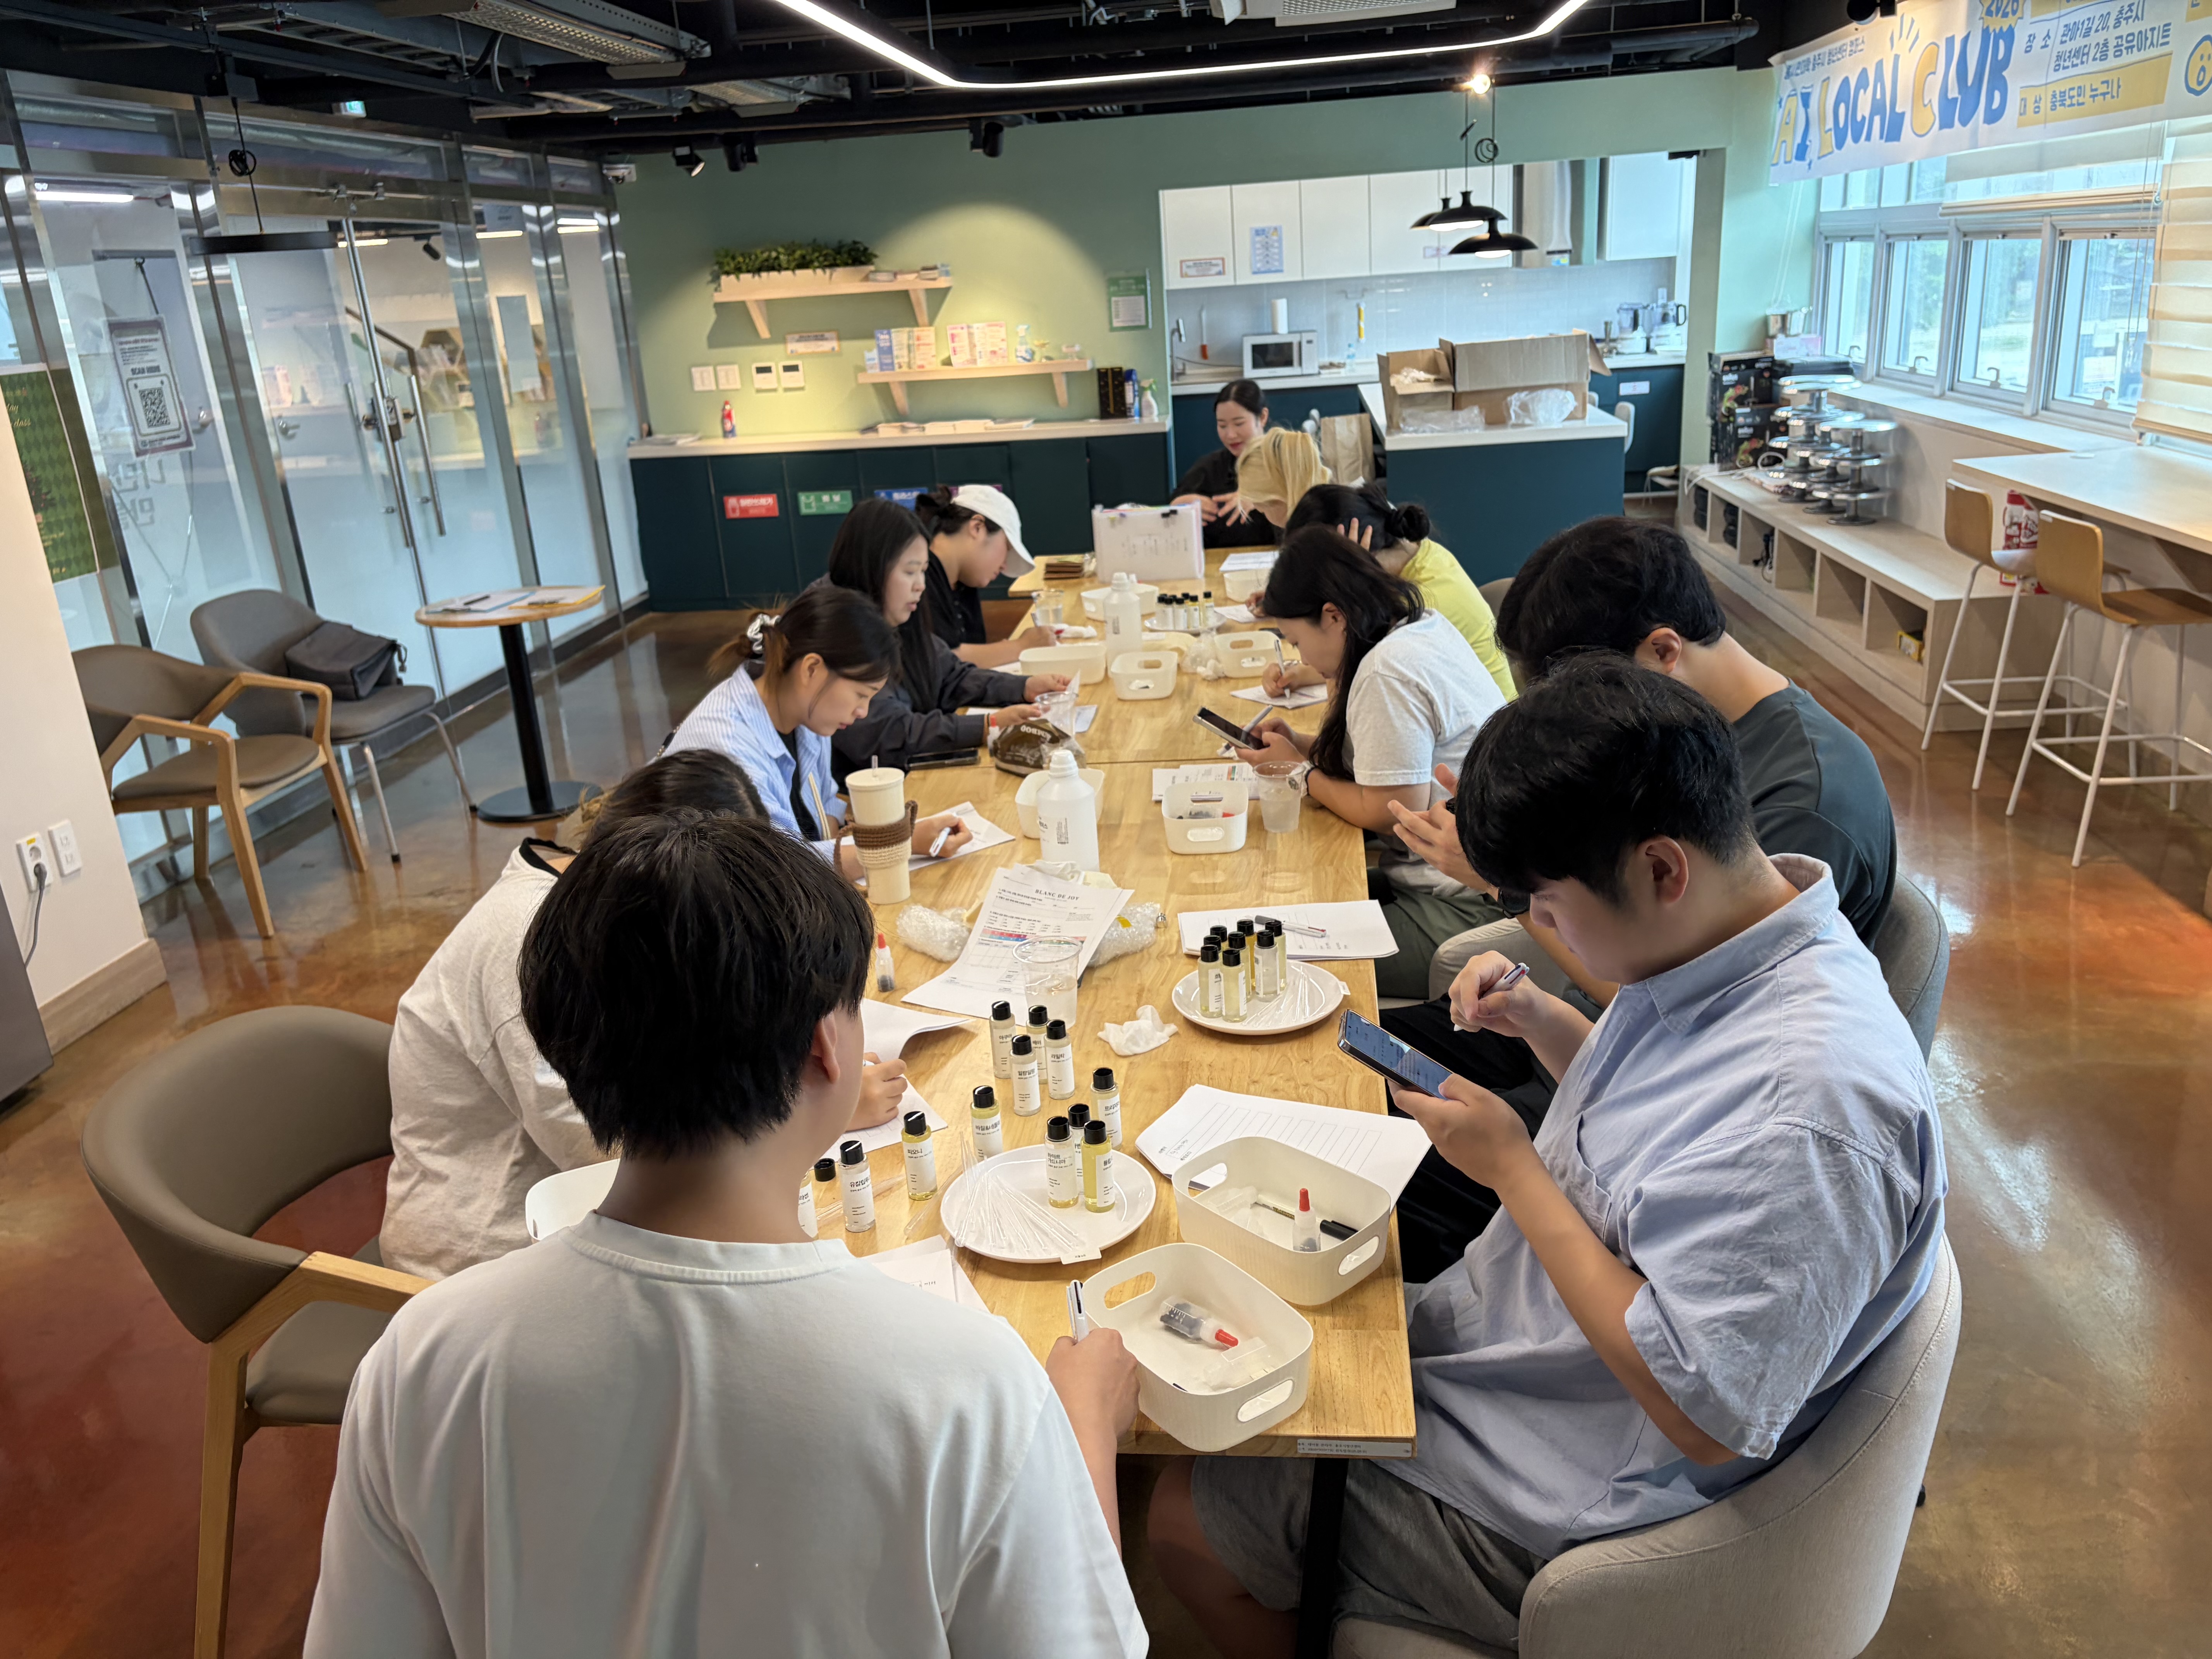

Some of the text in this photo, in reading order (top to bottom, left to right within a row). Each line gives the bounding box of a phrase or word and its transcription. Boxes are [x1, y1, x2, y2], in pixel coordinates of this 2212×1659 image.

[2060, 0, 2144, 45] 관아1길 20, 충주시
[2053, 22, 2172, 73] 청년센터 2층 공유아지트
[1818, 53, 1906, 160] LOCAL
[1911, 26, 2015, 137] CLUB
[2050, 77, 2121, 112] 충북도민 누구나
[1035, 889, 1056, 897] BLANC
